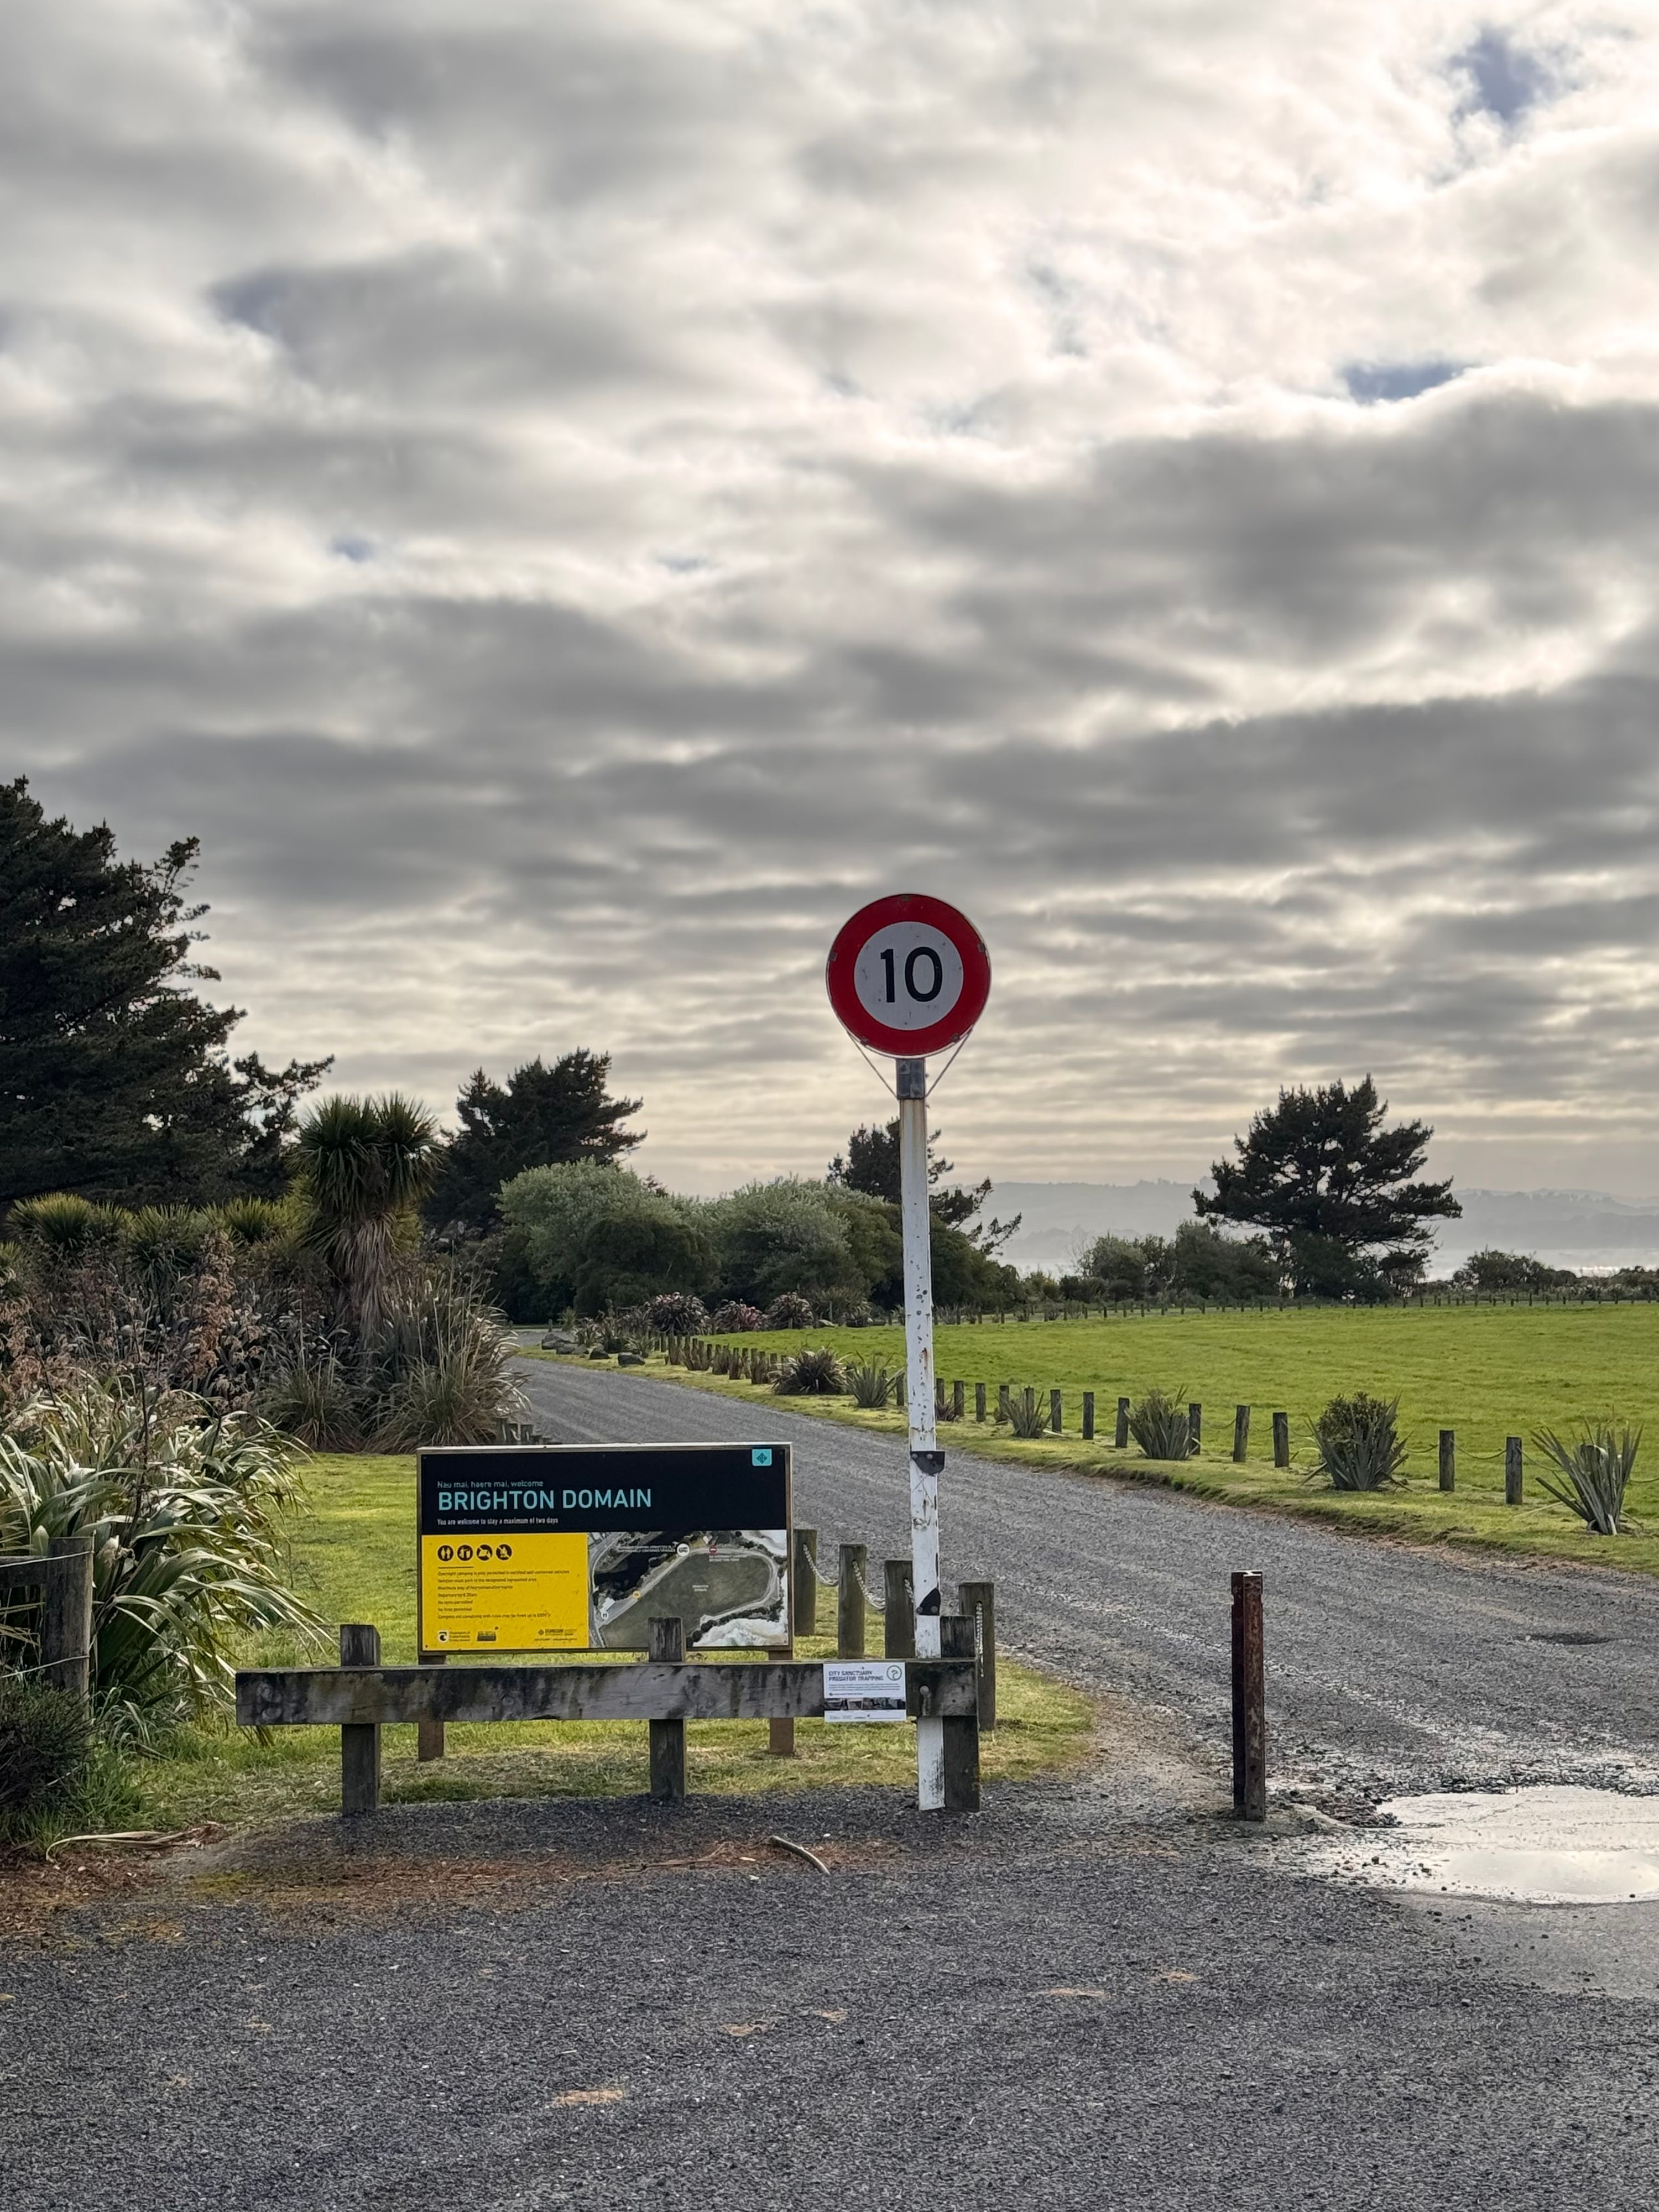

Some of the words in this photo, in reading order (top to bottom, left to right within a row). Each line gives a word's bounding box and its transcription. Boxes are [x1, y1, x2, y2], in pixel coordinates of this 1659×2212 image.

[880, 946, 943, 1003] 10
[439, 1490, 554, 1511] BRIGHTON
[562, 1489, 651, 1509] DOMAIN
[487, 1517, 498, 1526] stay
[546, 1516, 559, 1525] days
